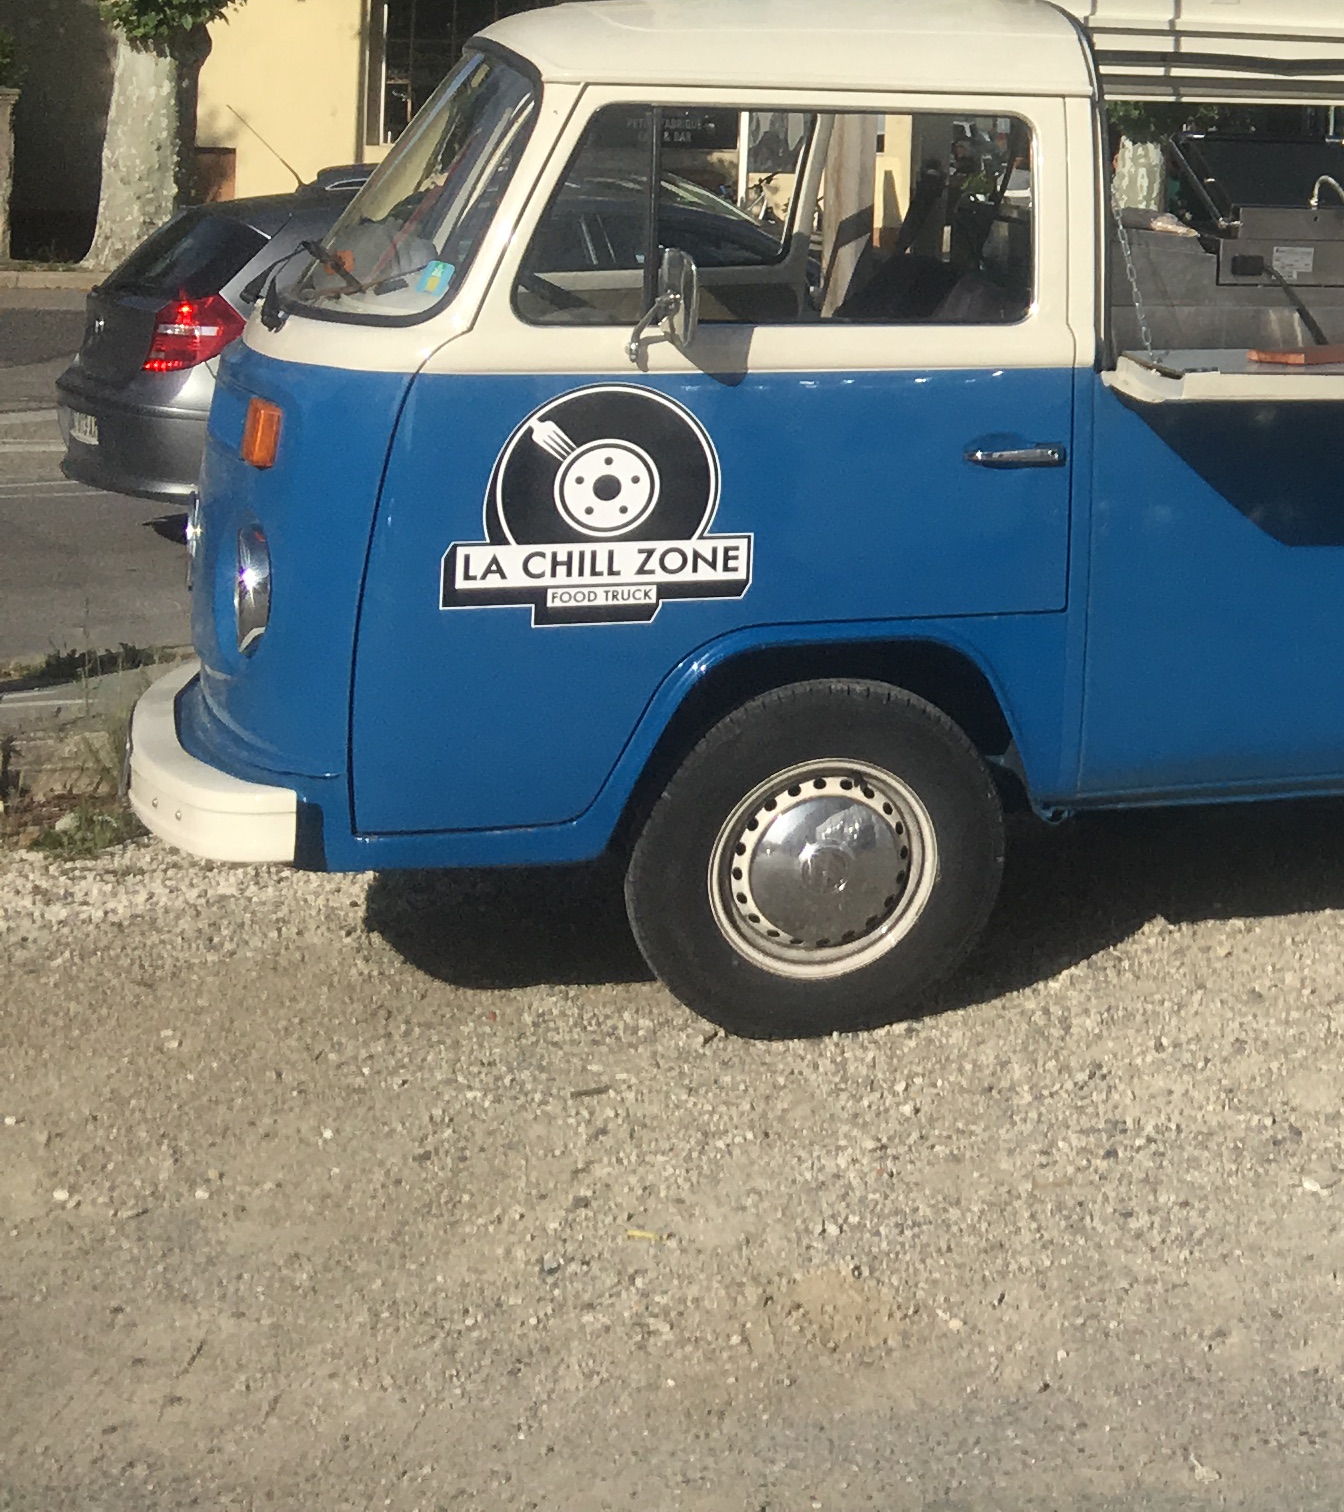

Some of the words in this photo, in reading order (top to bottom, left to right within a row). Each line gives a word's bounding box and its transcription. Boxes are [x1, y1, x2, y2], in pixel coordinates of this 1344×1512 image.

[463, 553, 507, 582] LA
[522, 548, 622, 579] CHILL
[634, 545, 740, 575] ZONE
[551, 589, 598, 604] FOOD
[604, 587, 653, 603] TRUCK
